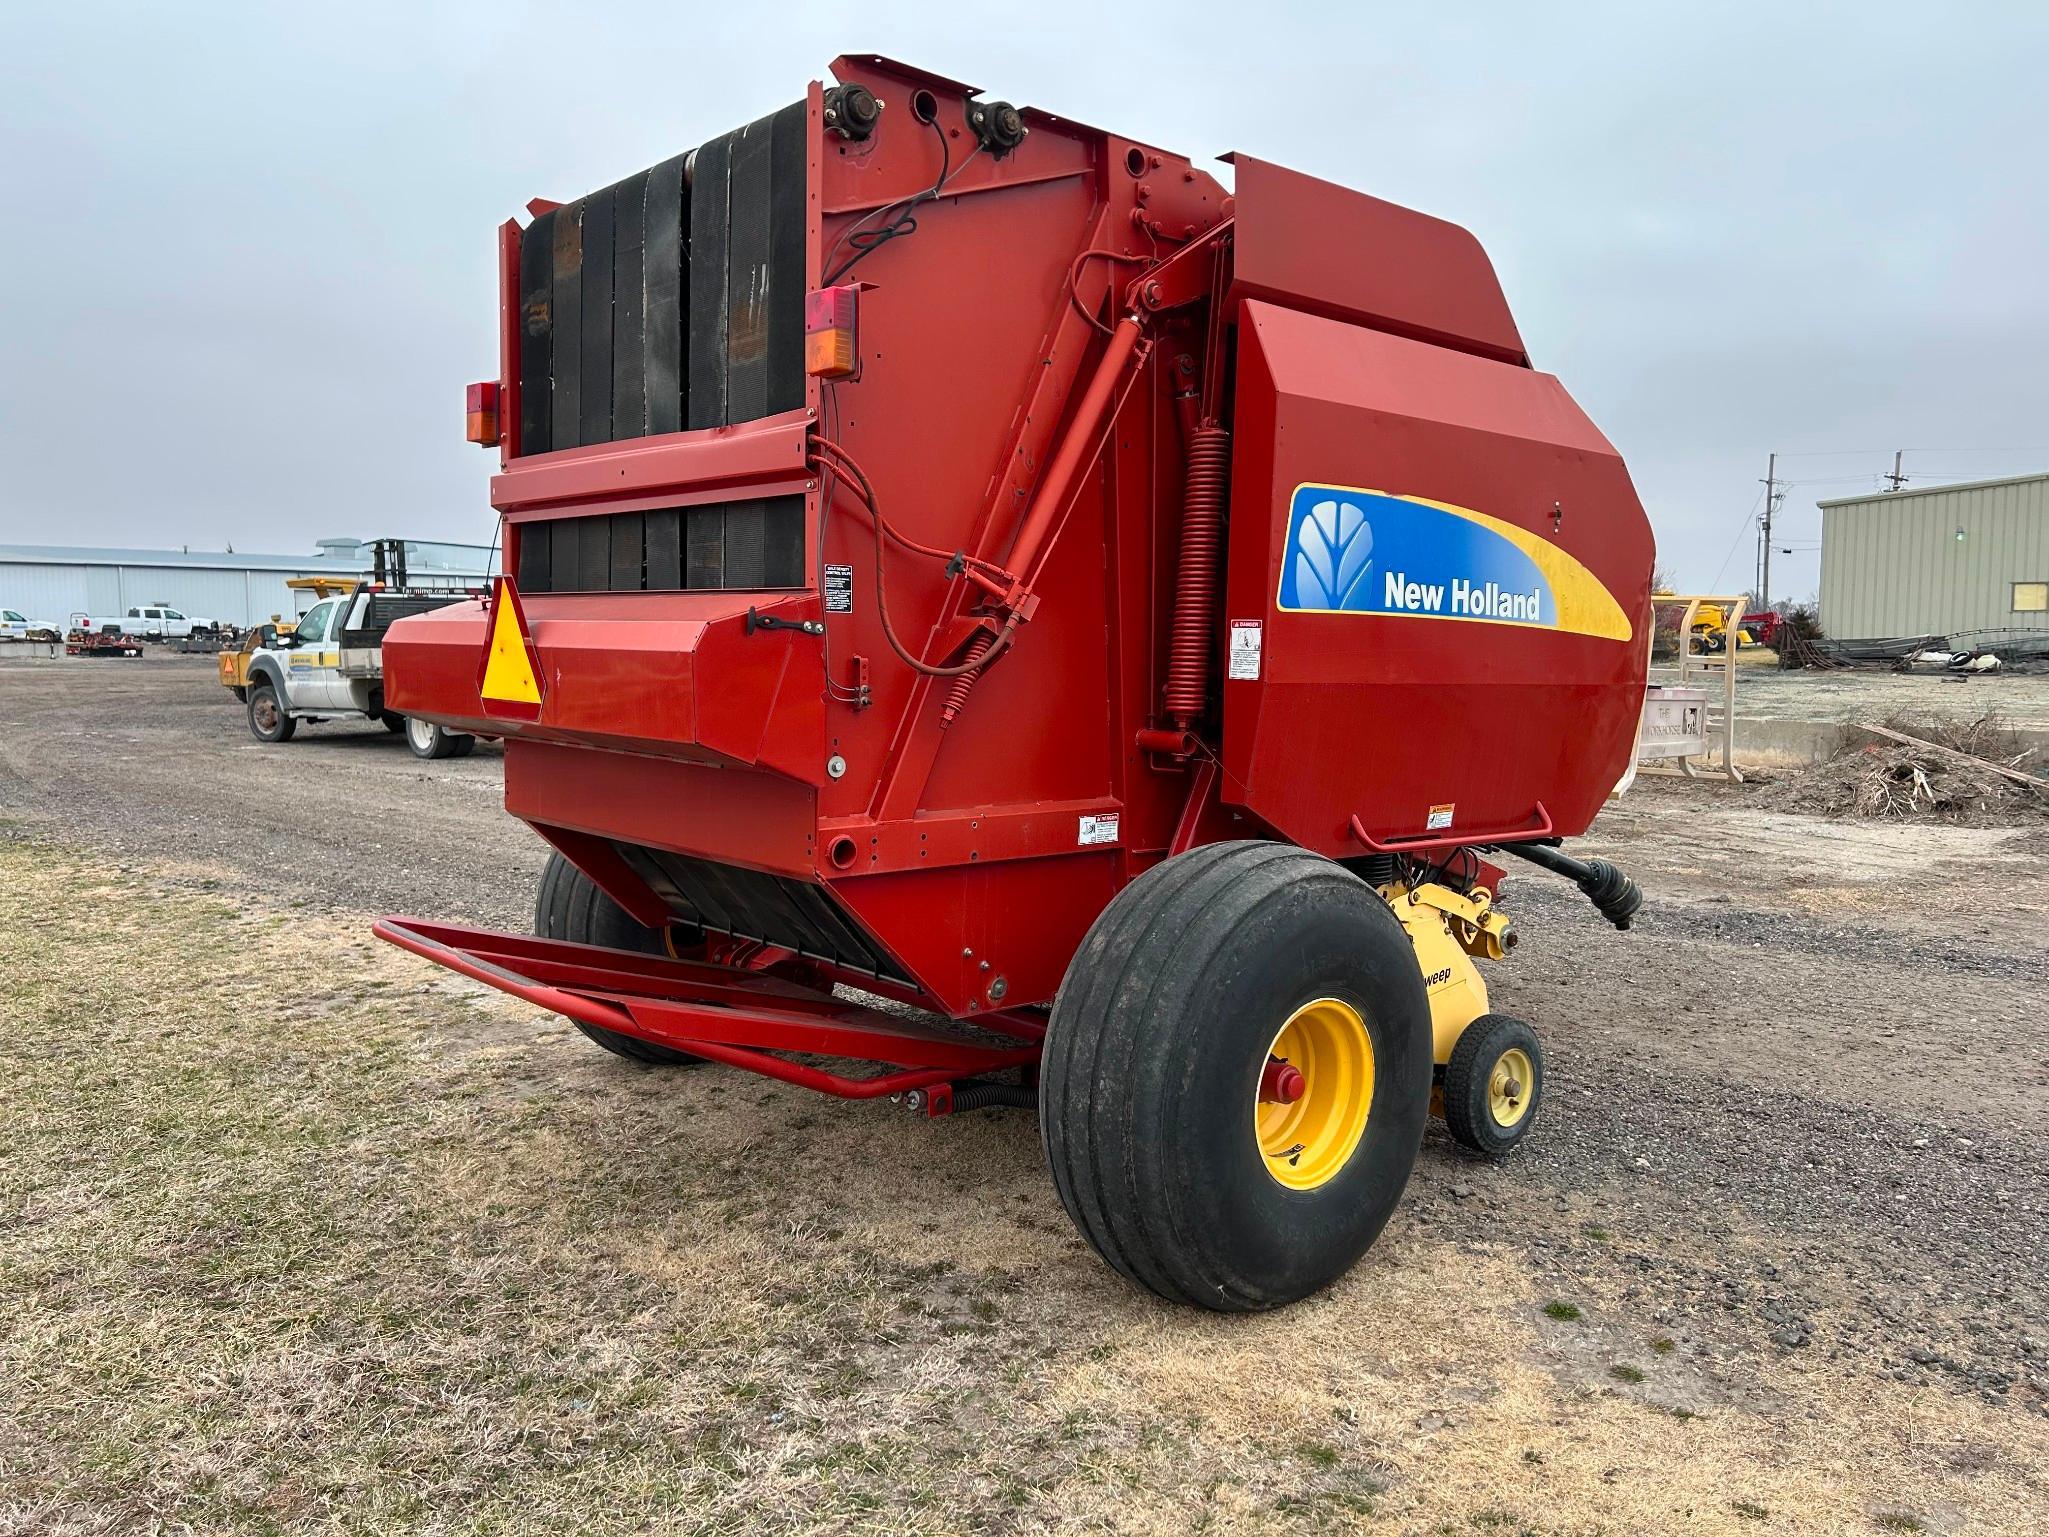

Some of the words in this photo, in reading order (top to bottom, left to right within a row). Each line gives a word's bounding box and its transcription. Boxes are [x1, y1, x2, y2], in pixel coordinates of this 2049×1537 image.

[1384, 571, 1445, 611] New
[1451, 578, 1541, 621] Holland
[1424, 967, 1451, 987] weep
